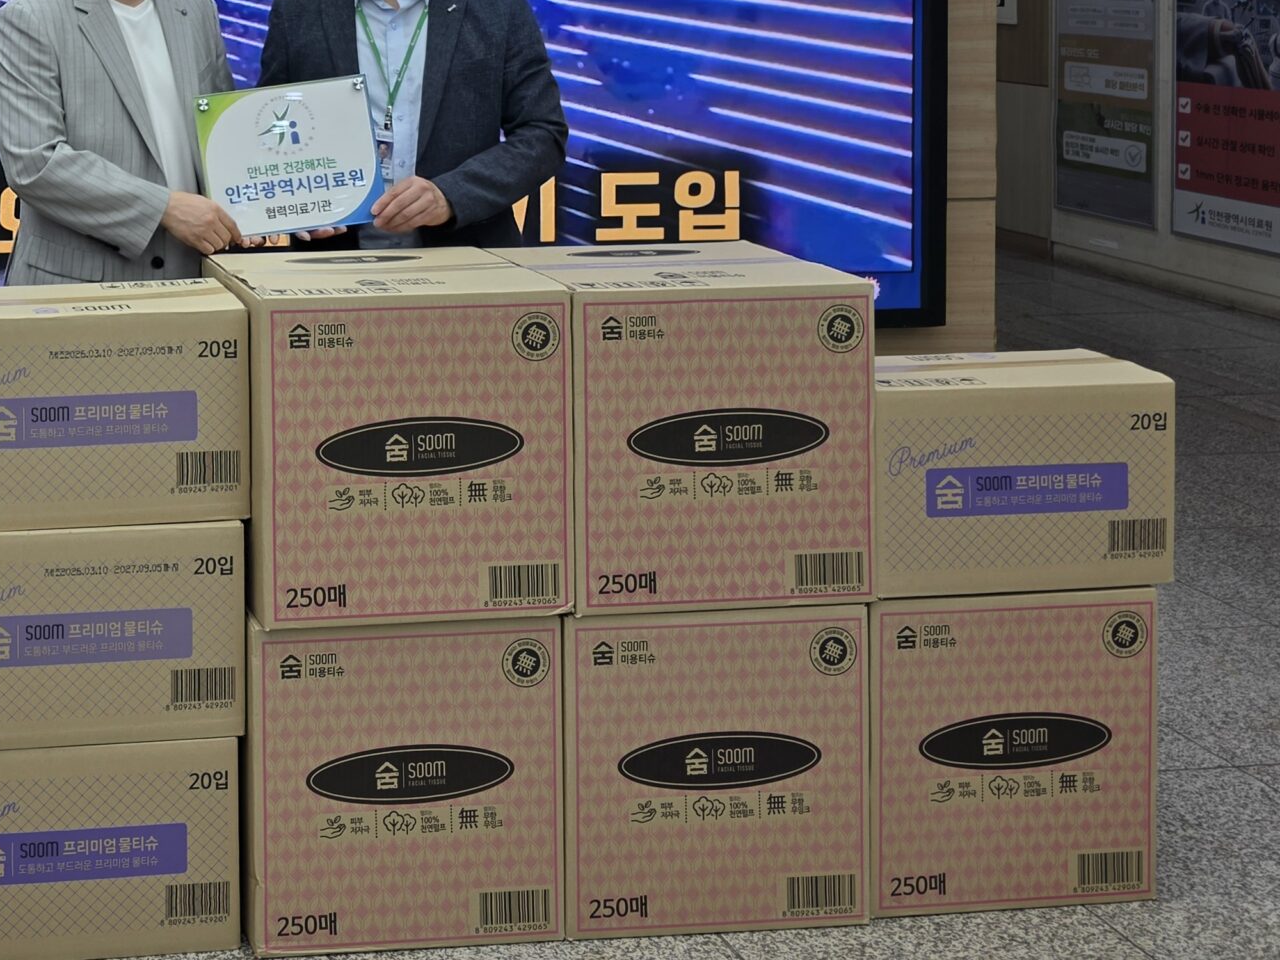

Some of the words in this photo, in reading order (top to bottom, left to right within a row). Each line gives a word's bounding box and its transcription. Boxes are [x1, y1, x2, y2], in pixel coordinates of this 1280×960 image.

[247, 163, 280, 180] 만나면
[283, 156, 337, 175] 건강해지는
[225, 168, 366, 205] 인천광역시의료원
[265, 199, 332, 219] 협력의료기관
[596, 170, 740, 241] 도입
[318, 336, 353, 348] 미용티슈
[629, 329, 664, 340] 미용티슈
[198, 340, 237, 358] 20입
[74, 405, 126, 421] 프리미엄
[129, 402, 168, 418] 물티슈
[1130, 412, 1167, 430] 20입
[889, 437, 976, 476] Premium
[775, 471, 794, 492] 無
[1016, 474, 1064, 490] 프리미엄
[1067, 473, 1102, 488] 물티슈
[429, 488, 448, 497] 100%
[468, 481, 487, 503] 無
[194, 556, 234, 575] 20입
[598, 572, 657, 595] 250매
[286, 585, 346, 608] 250매
[68, 621, 121, 638] 프리미엄
[124, 619, 163, 636] 물티슈
[923, 637, 956, 648] 미용티슈
[621, 654, 656, 665] 미용티슈
[309, 666, 344, 678] 미용티슈
[189, 771, 229, 790] 20입
[1059, 773, 1078, 793] 無
[767, 794, 786, 815] 無
[458, 808, 478, 829] 無
[63, 839, 116, 855] 프리미엄
[119, 836, 158, 852] 물티슈
[891, 873, 946, 896] 250매
[589, 895, 648, 919] 250매
[277, 912, 337, 936] 250매
